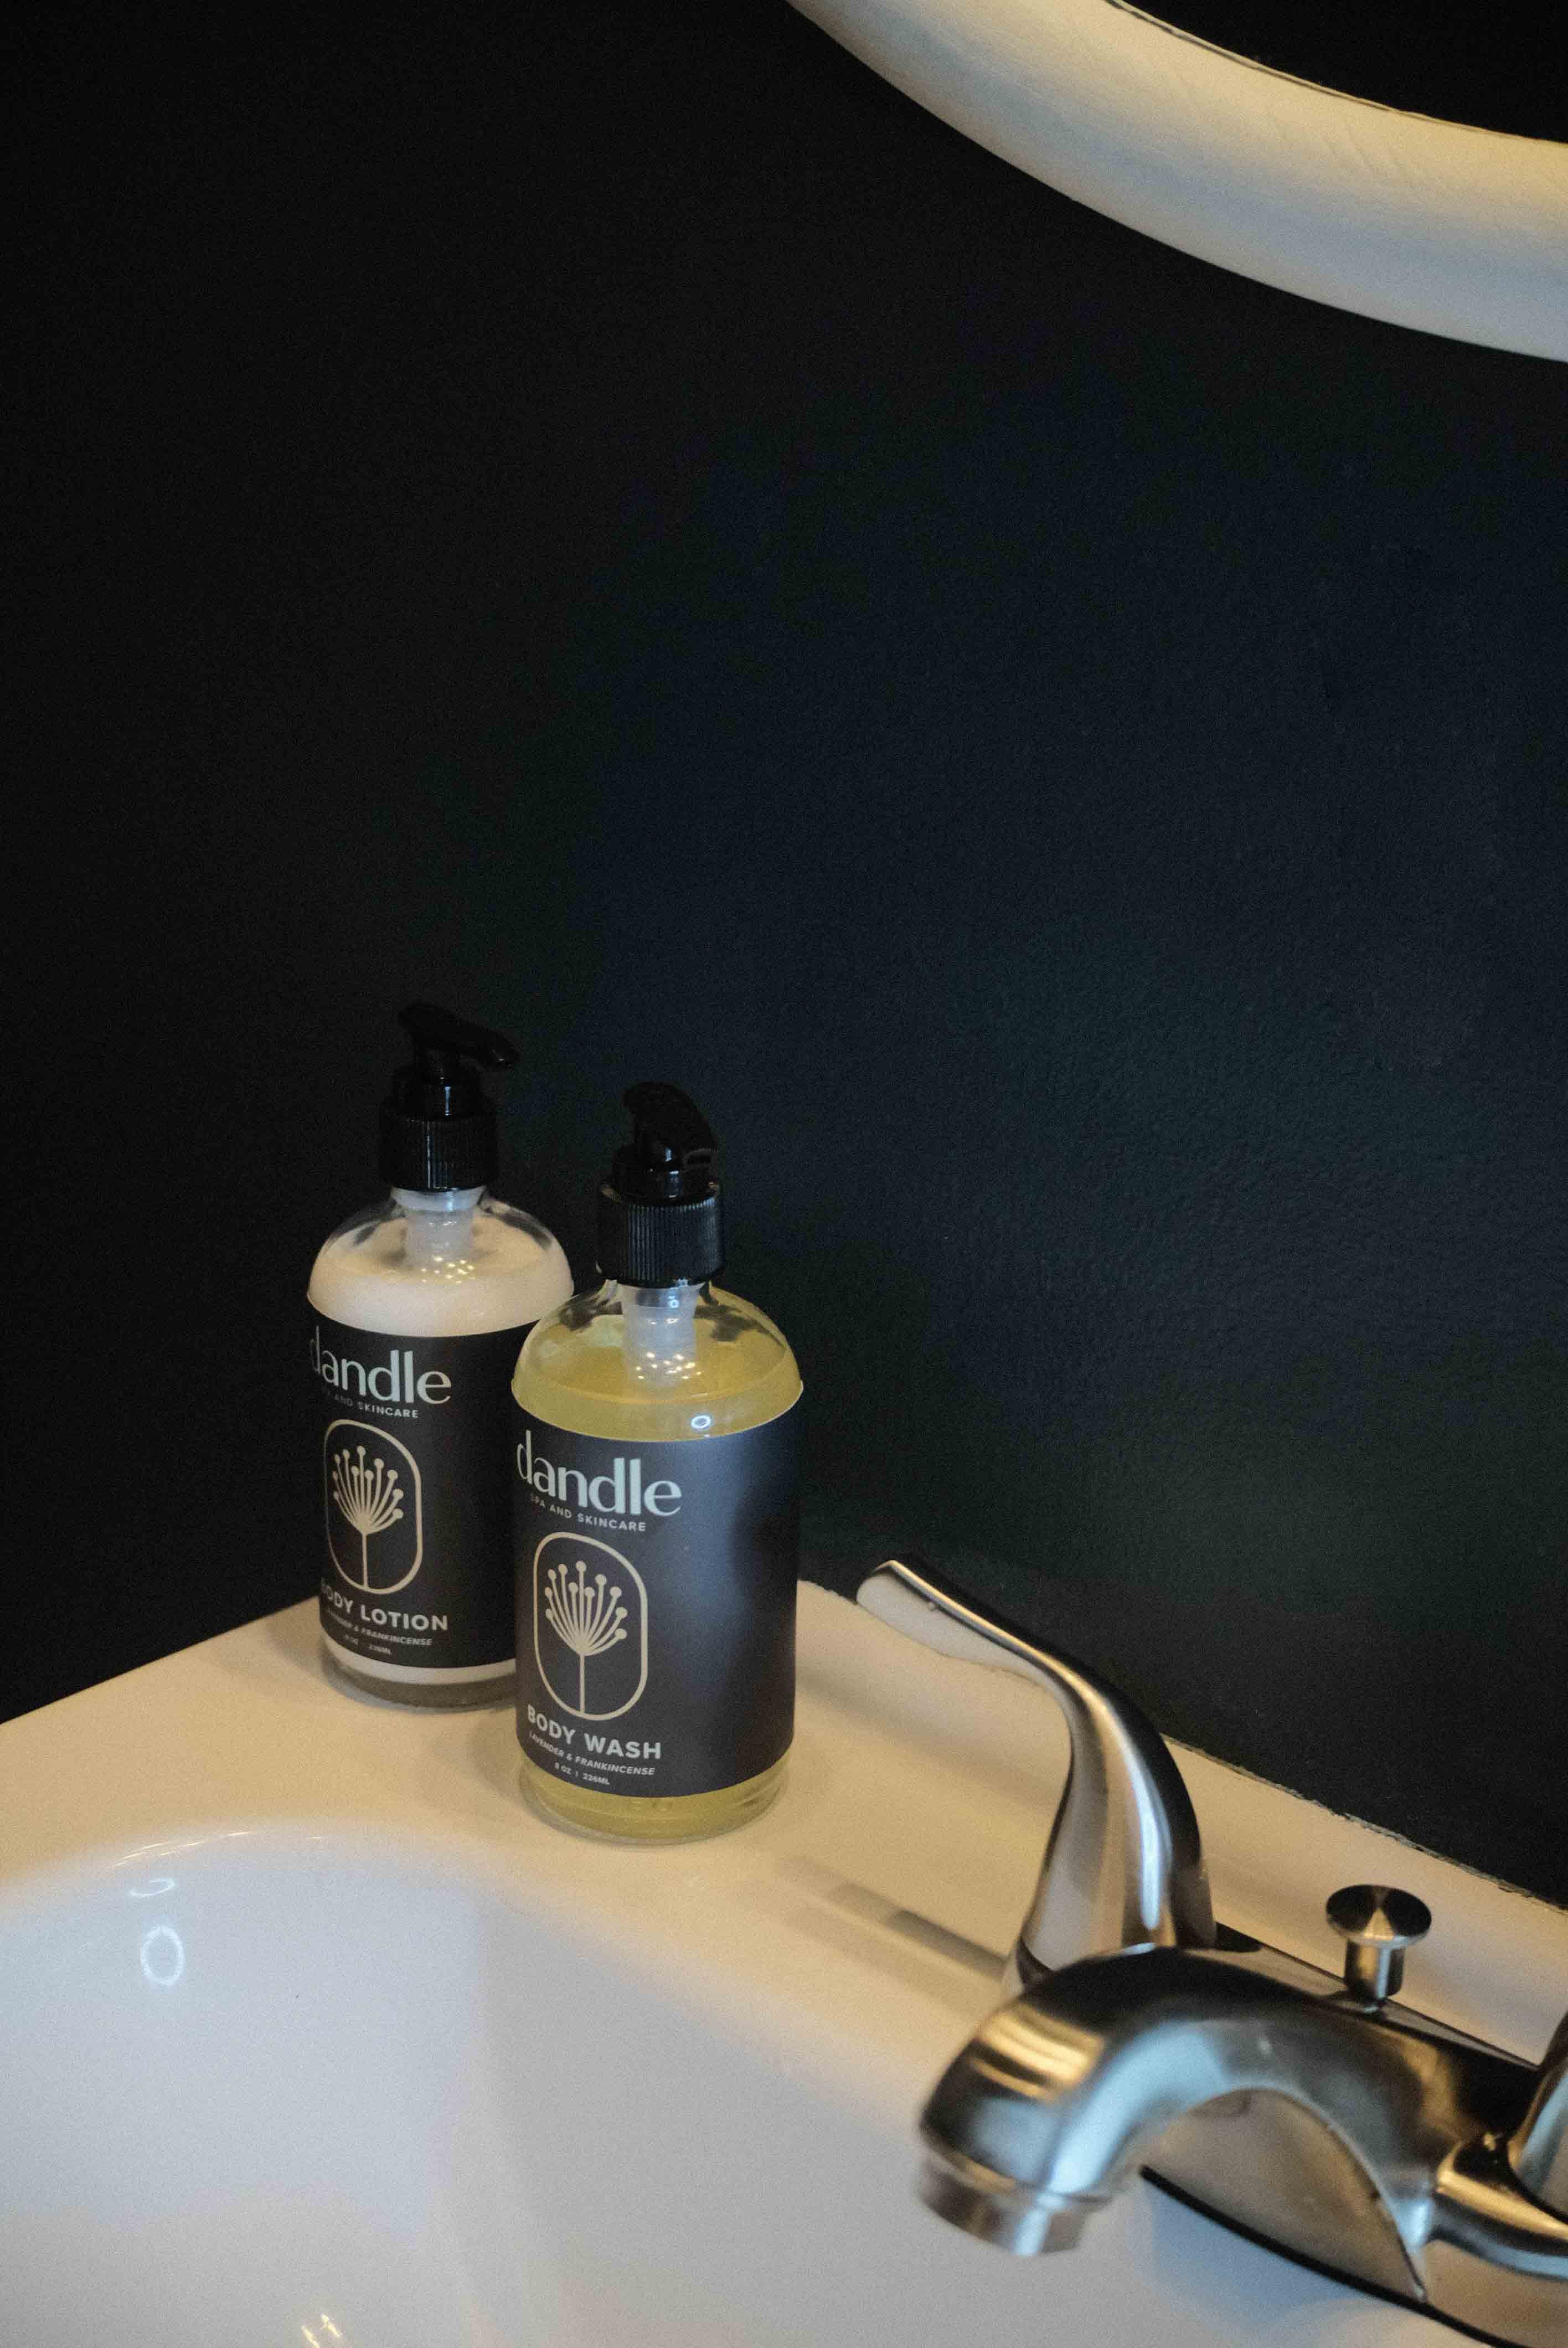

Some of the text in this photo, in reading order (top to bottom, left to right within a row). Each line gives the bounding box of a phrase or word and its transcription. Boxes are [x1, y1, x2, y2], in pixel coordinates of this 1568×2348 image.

[310, 1325, 452, 1404] dandle
[357, 1401, 419, 1418] SKINCARE
[517, 1429, 683, 1517] dandle
[549, 1504, 572, 1519] AND
[577, 1512, 647, 1532] SKINCARE
[360, 1604, 448, 1631] LOTION
[362, 1628, 433, 1646] FRANKINCENSE
[527, 1704, 661, 1760] BODY WASH
[529, 1731, 564, 1758] LAVENDER
[575, 1756, 656, 1775] FRANKINCENSE
